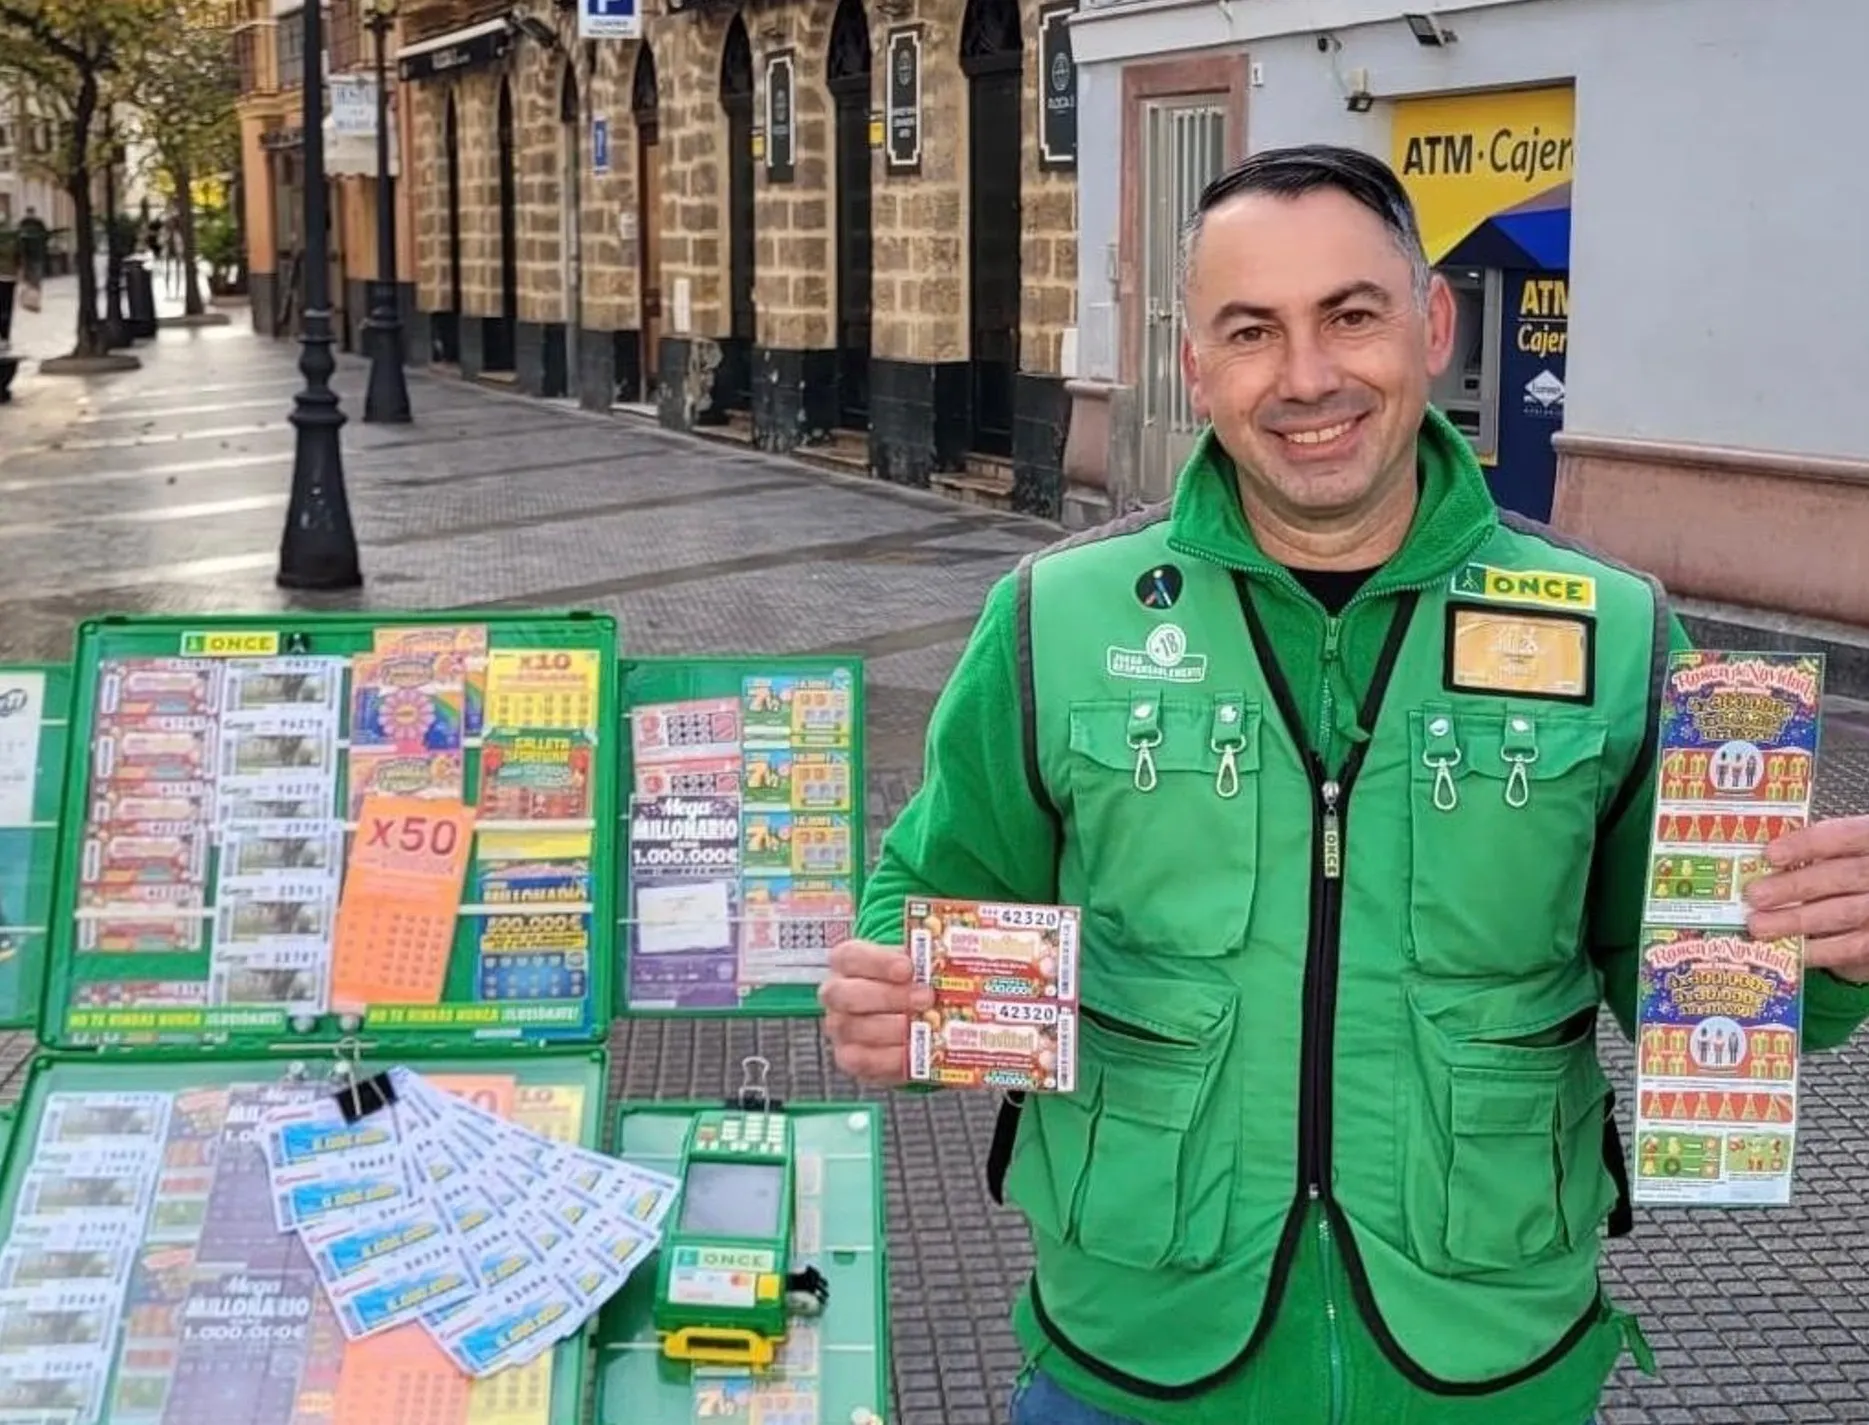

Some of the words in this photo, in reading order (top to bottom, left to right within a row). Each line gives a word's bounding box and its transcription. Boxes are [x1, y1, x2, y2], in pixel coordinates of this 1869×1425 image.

[1403, 136, 1473, 175] ATM
[1489, 128, 1573, 182] Cajer
[1493, 576, 1584, 601] ONCE
[210, 636, 274, 651] ONCE
[632, 819, 738, 841] MILLONARIO
[1001, 909, 1057, 927] 42320
[999, 1005, 1054, 1021] 42320
[704, 1253, 764, 1266] ONCE
